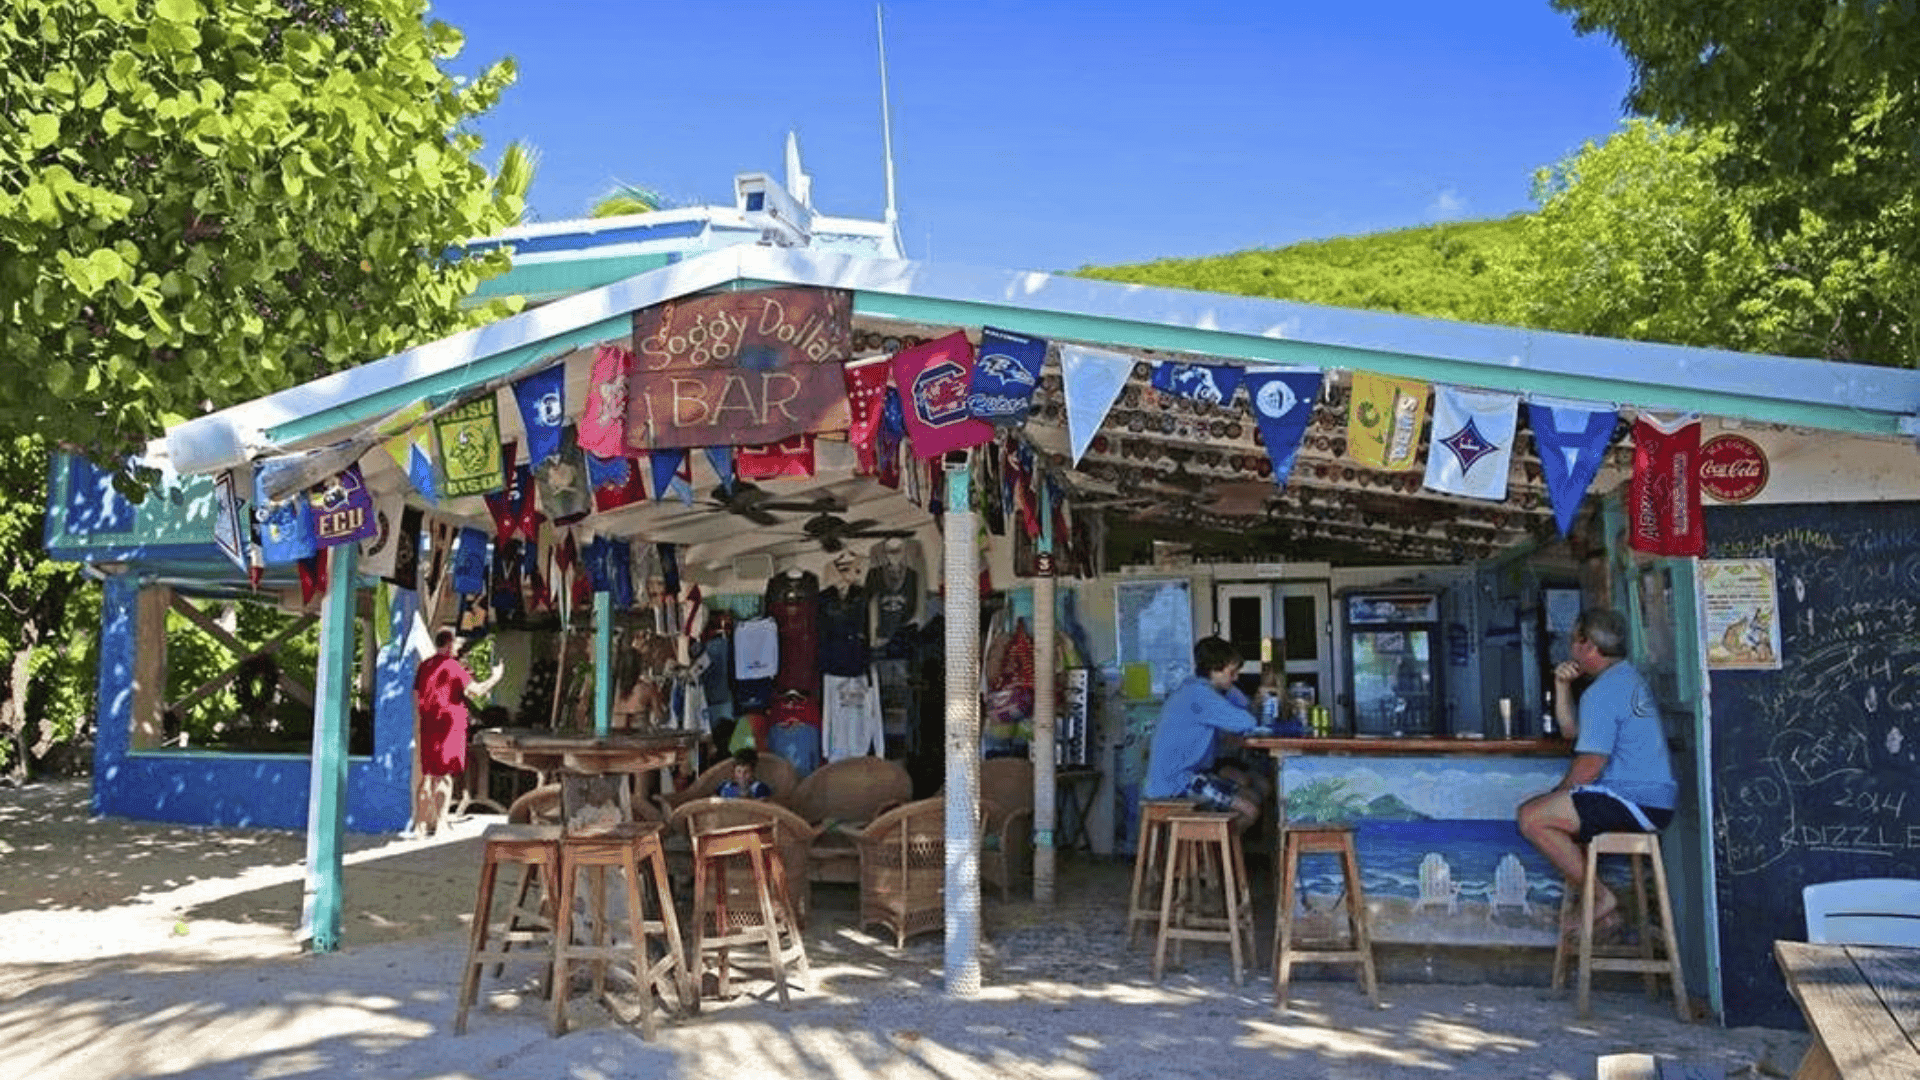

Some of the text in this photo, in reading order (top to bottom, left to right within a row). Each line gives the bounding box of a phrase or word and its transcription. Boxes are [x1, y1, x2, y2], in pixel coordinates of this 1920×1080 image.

[641, 297, 843, 371] Soggy Dollar
[671, 372, 801, 428] BAR
[319, 507, 364, 537] ECU
